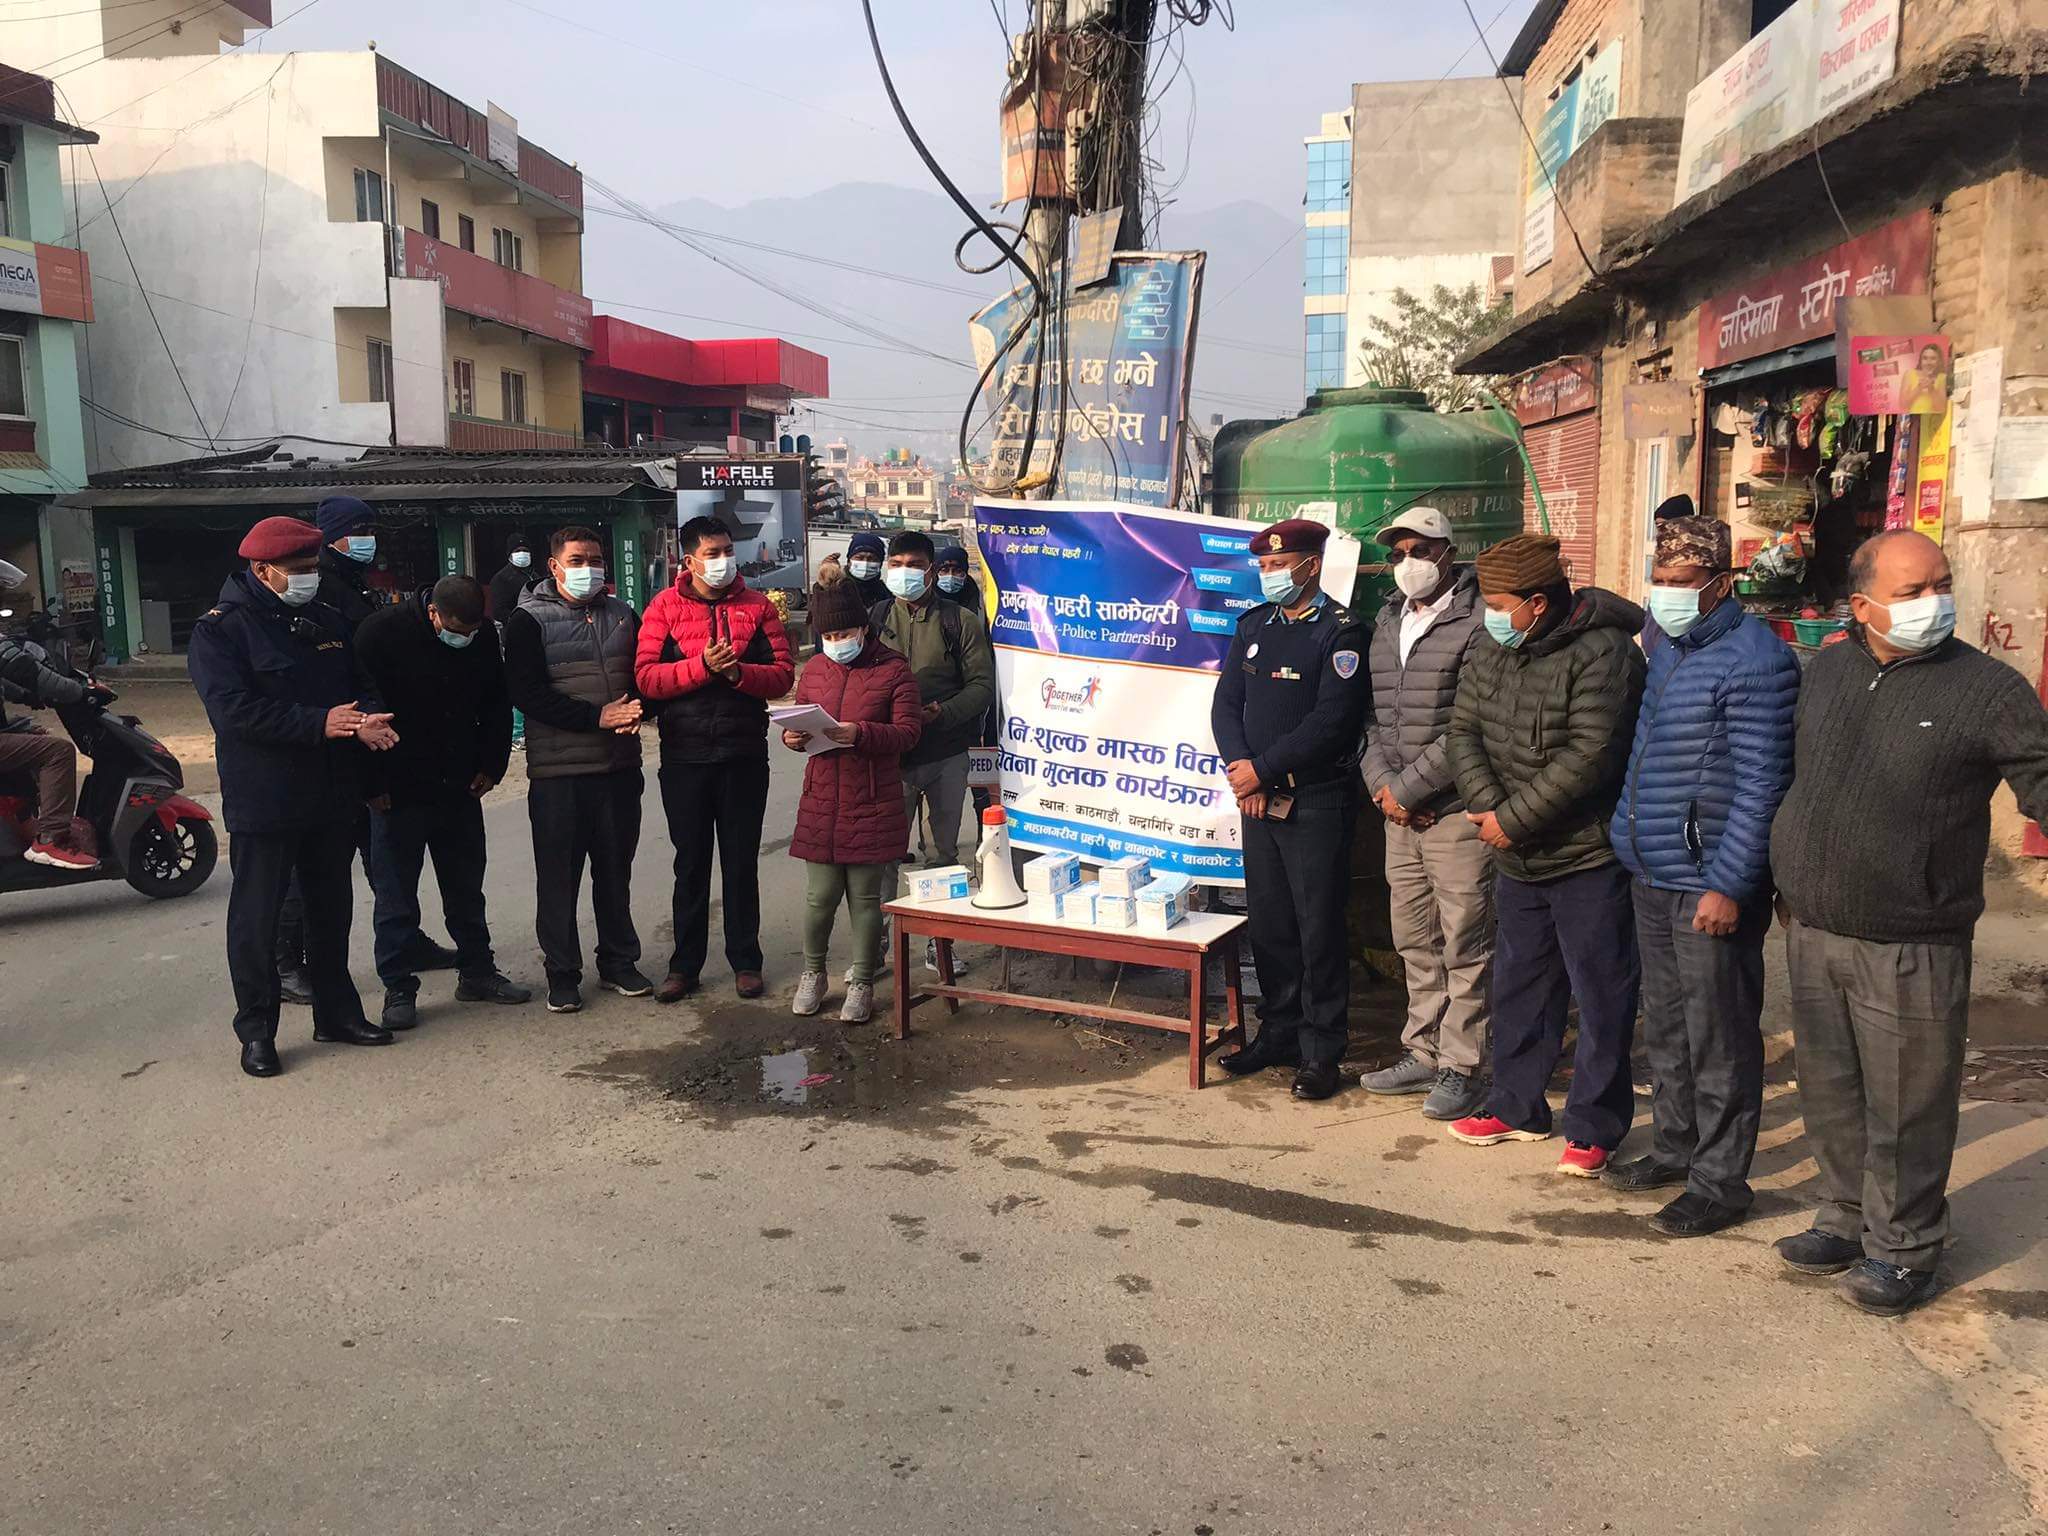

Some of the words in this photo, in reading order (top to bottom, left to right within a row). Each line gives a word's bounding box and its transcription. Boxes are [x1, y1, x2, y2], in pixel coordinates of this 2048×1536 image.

[1113, 351, 1159, 387] भने
[1255, 500, 1296, 518] PLUS
[1199, 573, 1233, 586] समुदाय
[1101, 627, 1178, 652] Partnership
[1097, 736, 1168, 765] मास्क
[970, 758, 993, 772] PEED
[1115, 771, 1224, 808] कार्यक्रम
[1179, 824, 1200, 839] वडा
[1229, 827, 1237, 842] १
[1081, 832, 1105, 848] प्रहरी
[1125, 841, 1167, 860] थानकोट
[1171, 850, 1178, 863] र
[1183, 853, 1232, 868] थानकोट
